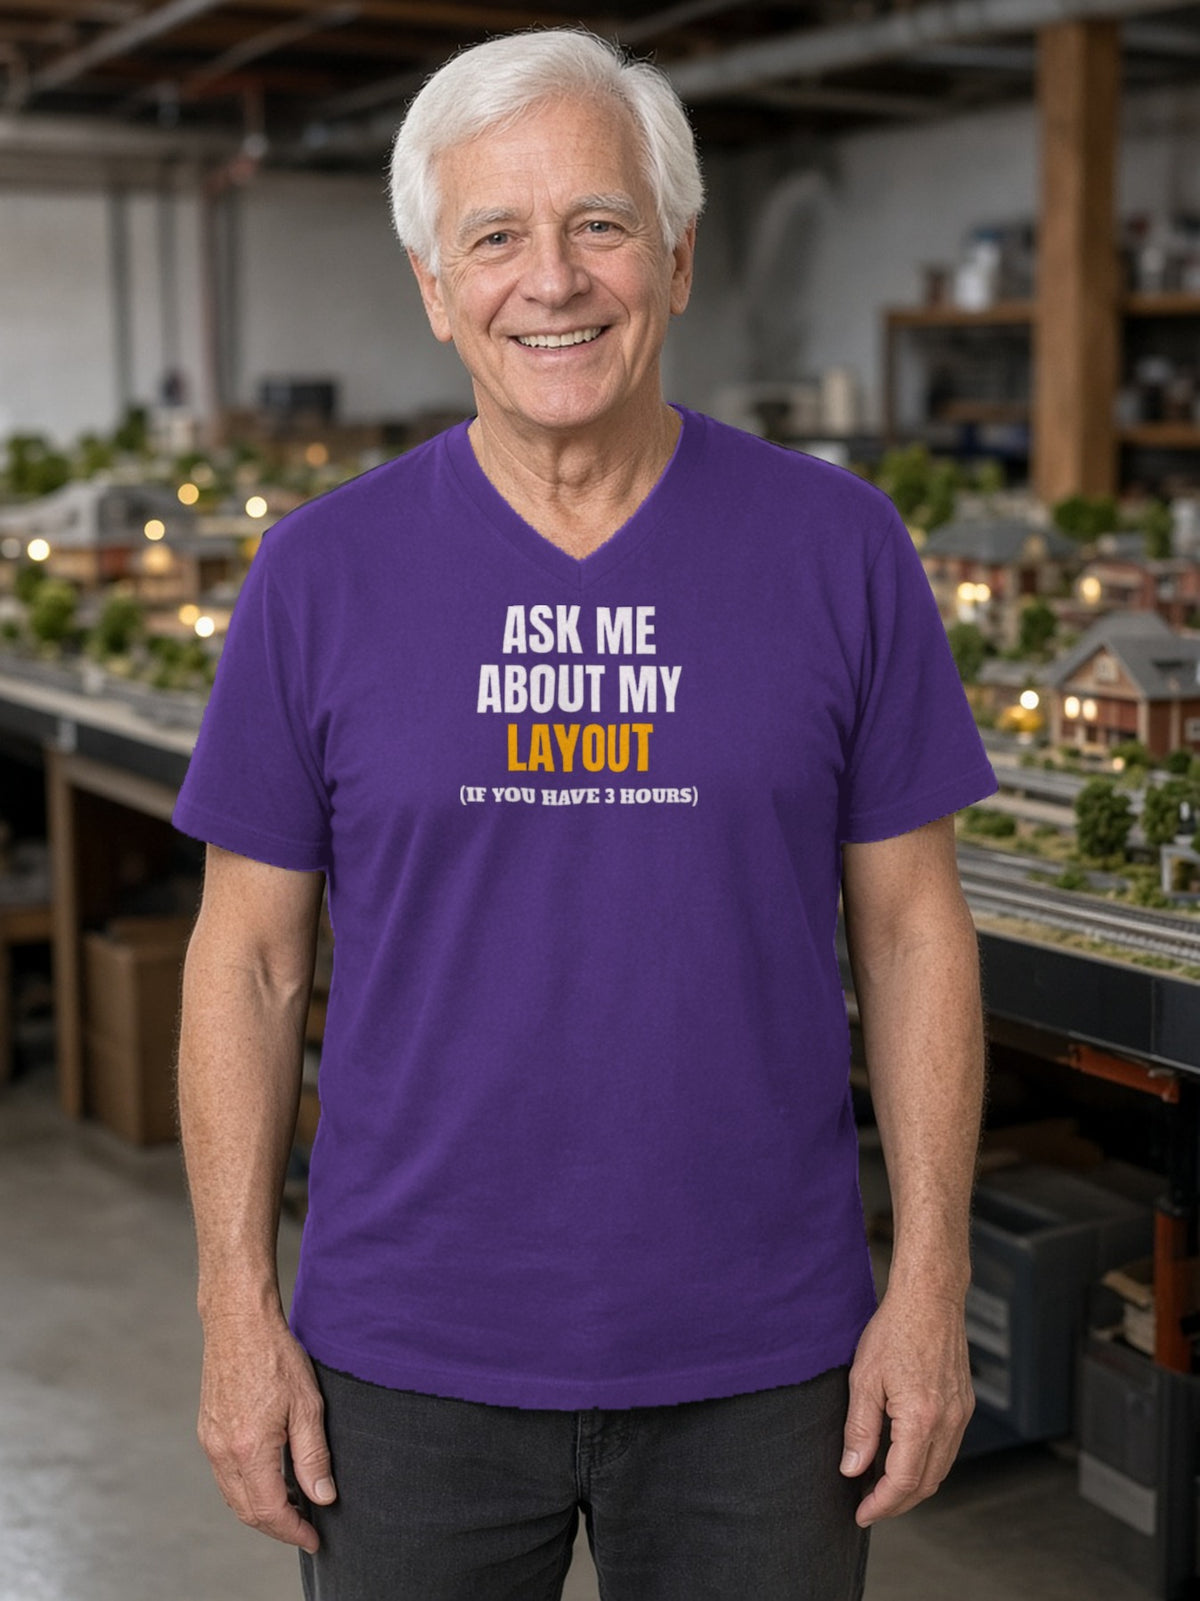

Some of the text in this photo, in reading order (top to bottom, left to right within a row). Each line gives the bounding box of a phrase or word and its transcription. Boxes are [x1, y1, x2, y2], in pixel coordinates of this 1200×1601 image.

[502, 604, 657, 655] ASK ME
[476, 664, 683, 714] ABOUT MY
[507, 723, 654, 773] LAYOUT
[459, 785, 699, 807] (IF YOU HAVE 3 HOURS)
